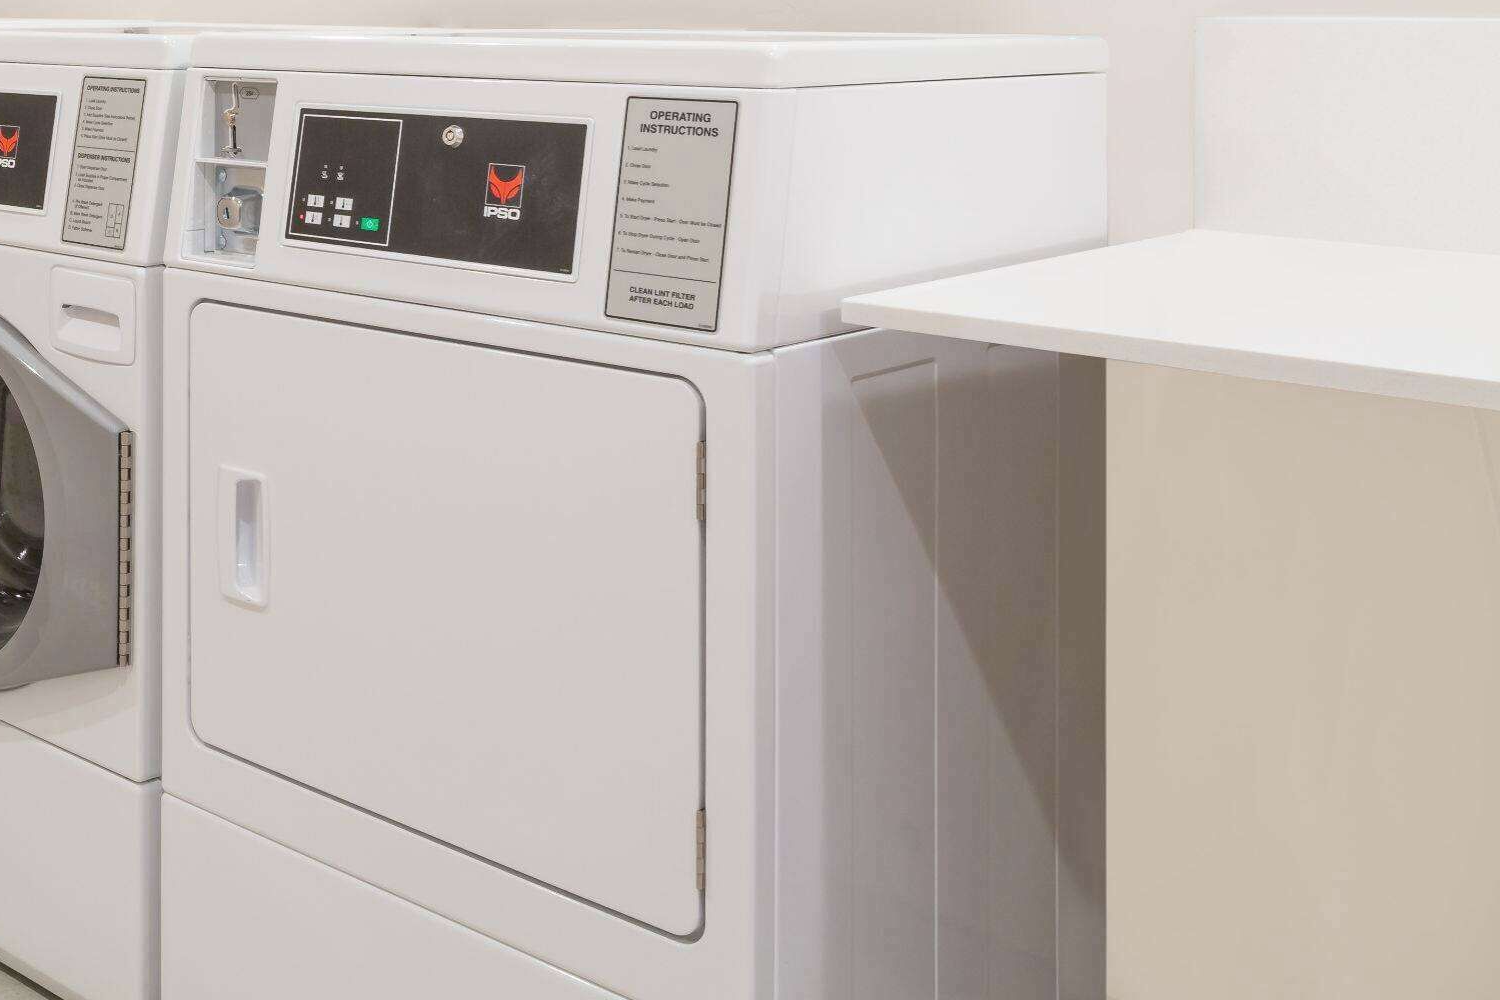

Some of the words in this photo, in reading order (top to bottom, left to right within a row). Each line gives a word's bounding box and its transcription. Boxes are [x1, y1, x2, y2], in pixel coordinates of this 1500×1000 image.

[650, 110, 711, 123] OPERATING
[640, 123, 719, 137] INSTRUCTIONS
[483, 206, 520, 220] IPSO
[630, 286, 653, 295] CLEAN
[671, 291, 696, 301] FILTER
[628, 295, 651, 304] AFTER
[653, 298, 672, 307] EACH
[674, 301, 694, 310] LOAD
